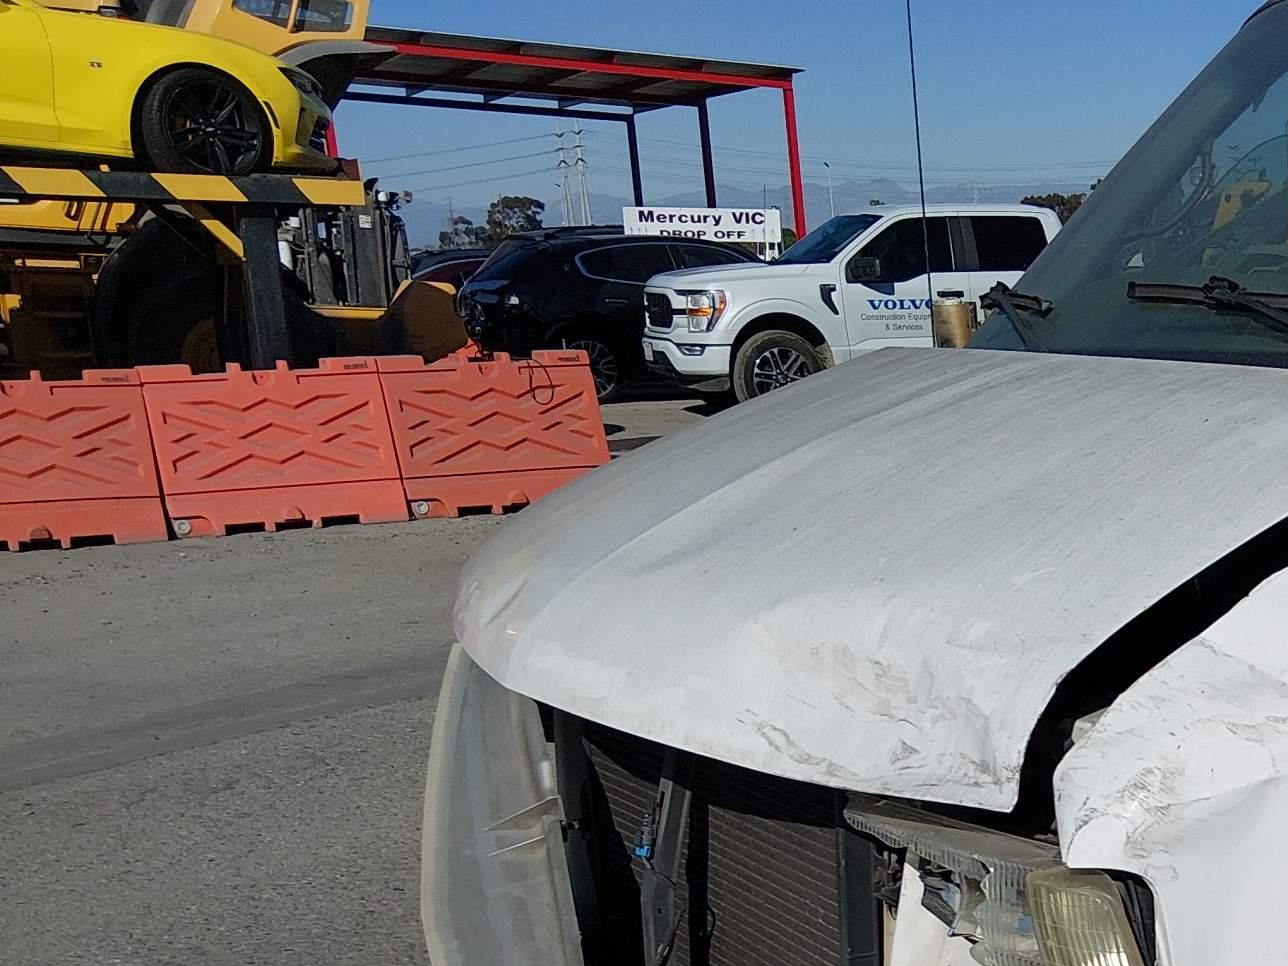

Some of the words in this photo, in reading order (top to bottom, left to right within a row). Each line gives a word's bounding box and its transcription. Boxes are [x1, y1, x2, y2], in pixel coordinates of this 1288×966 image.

[638, 210, 722, 227] Mercury
[731, 211, 765, 225] VIC
[659, 229, 707, 239] DROP
[714, 230, 747, 240] OFF
[861, 313, 905, 321] Construction
[908, 313, 931, 322] Equip
[893, 323, 923, 331] Services
